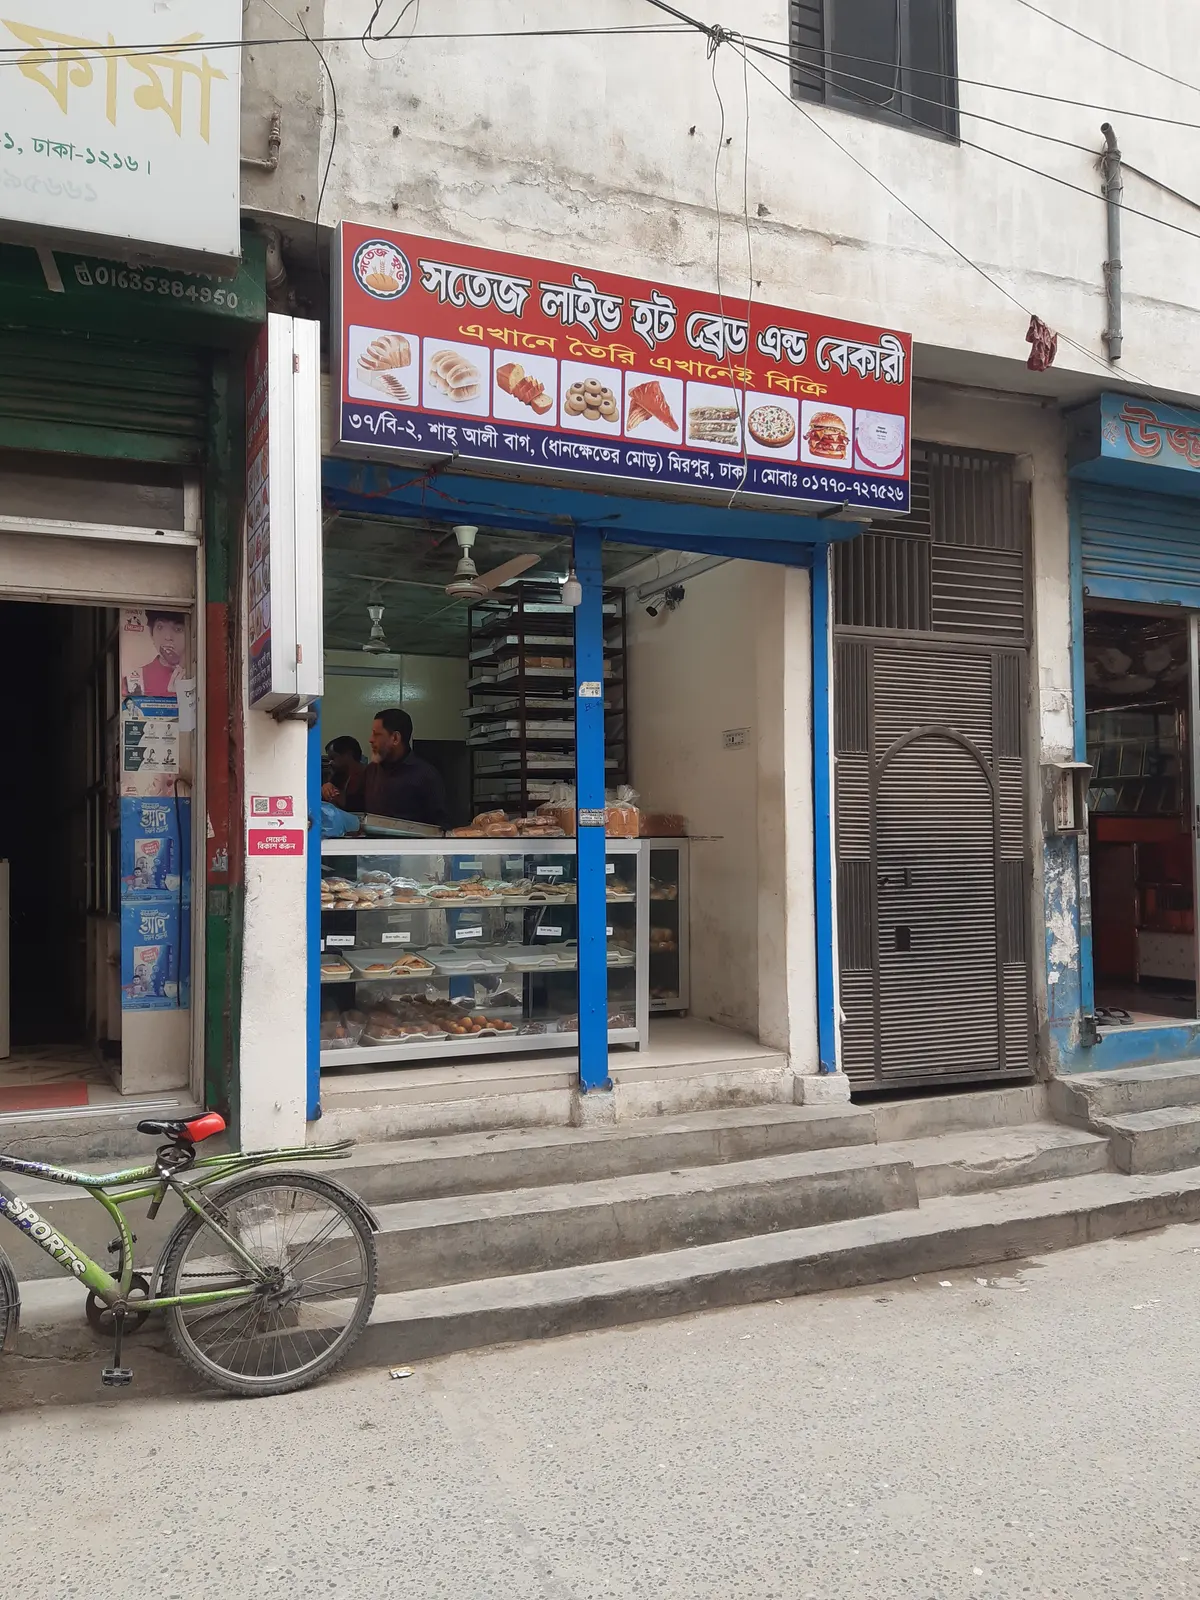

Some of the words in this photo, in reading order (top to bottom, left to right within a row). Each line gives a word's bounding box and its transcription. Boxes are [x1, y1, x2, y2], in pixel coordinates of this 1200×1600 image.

[360, 248, 390, 276] সতেজ
[418, 259, 531, 318] সতেজ
[539, 273, 623, 339] লাইভ
[630, 290, 676, 349] হট
[685, 311, 750, 361] ব্রেড
[757, 325, 808, 365] এন্ড
[816, 333, 906, 384] বেকারী
[459, 324, 557, 352] এখানে
[566, 335, 636, 366] তৈরি
[650, 357, 756, 388] এখানেই
[765, 370, 828, 397] বিক্রি
[349, 411, 422, 442] ৩৭/বি-২,
[462, 425, 499, 448] আলী
[503, 433, 535, 456] বাগ,
[542, 436, 620, 464] (ধানক্ষেতের
[625, 450, 663, 473] মোড়)
[668, 451, 714, 480] মিরপুর,
[761, 469, 797, 488] মোবাঃ
[802, 475, 904, 501] ০১৭৭০-৭২৭৫২৬
[6, 1196, 87, 1277] SPORTS
